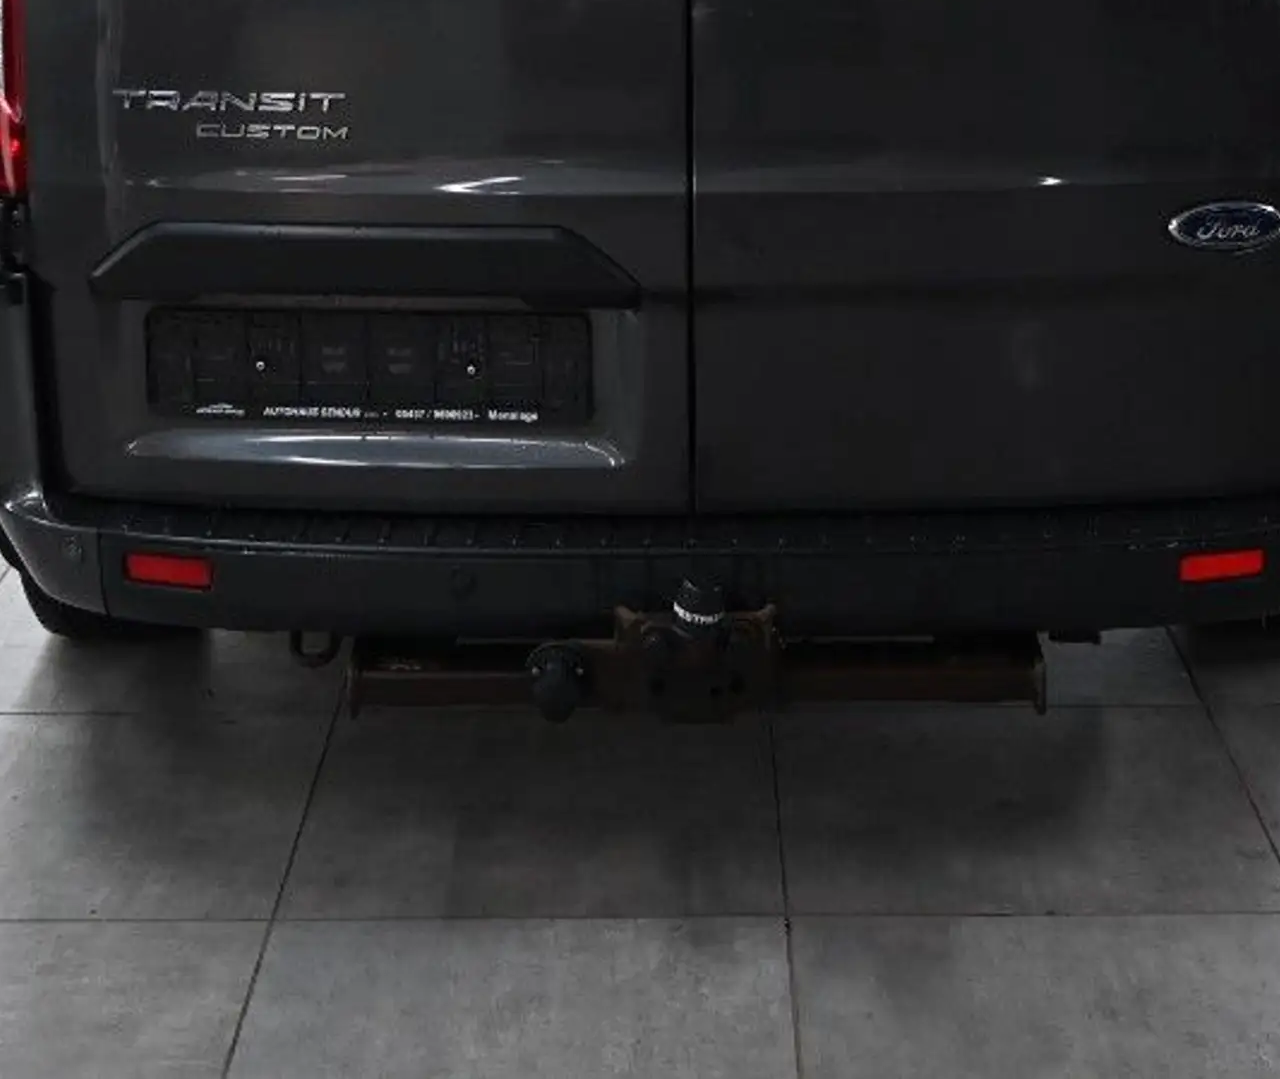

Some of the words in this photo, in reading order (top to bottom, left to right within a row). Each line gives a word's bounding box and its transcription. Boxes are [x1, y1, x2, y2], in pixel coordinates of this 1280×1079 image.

[112, 89, 347, 113] TRANSIT
[196, 123, 349, 141] CUSTOM
[1196, 218, 1261, 241] Ford
